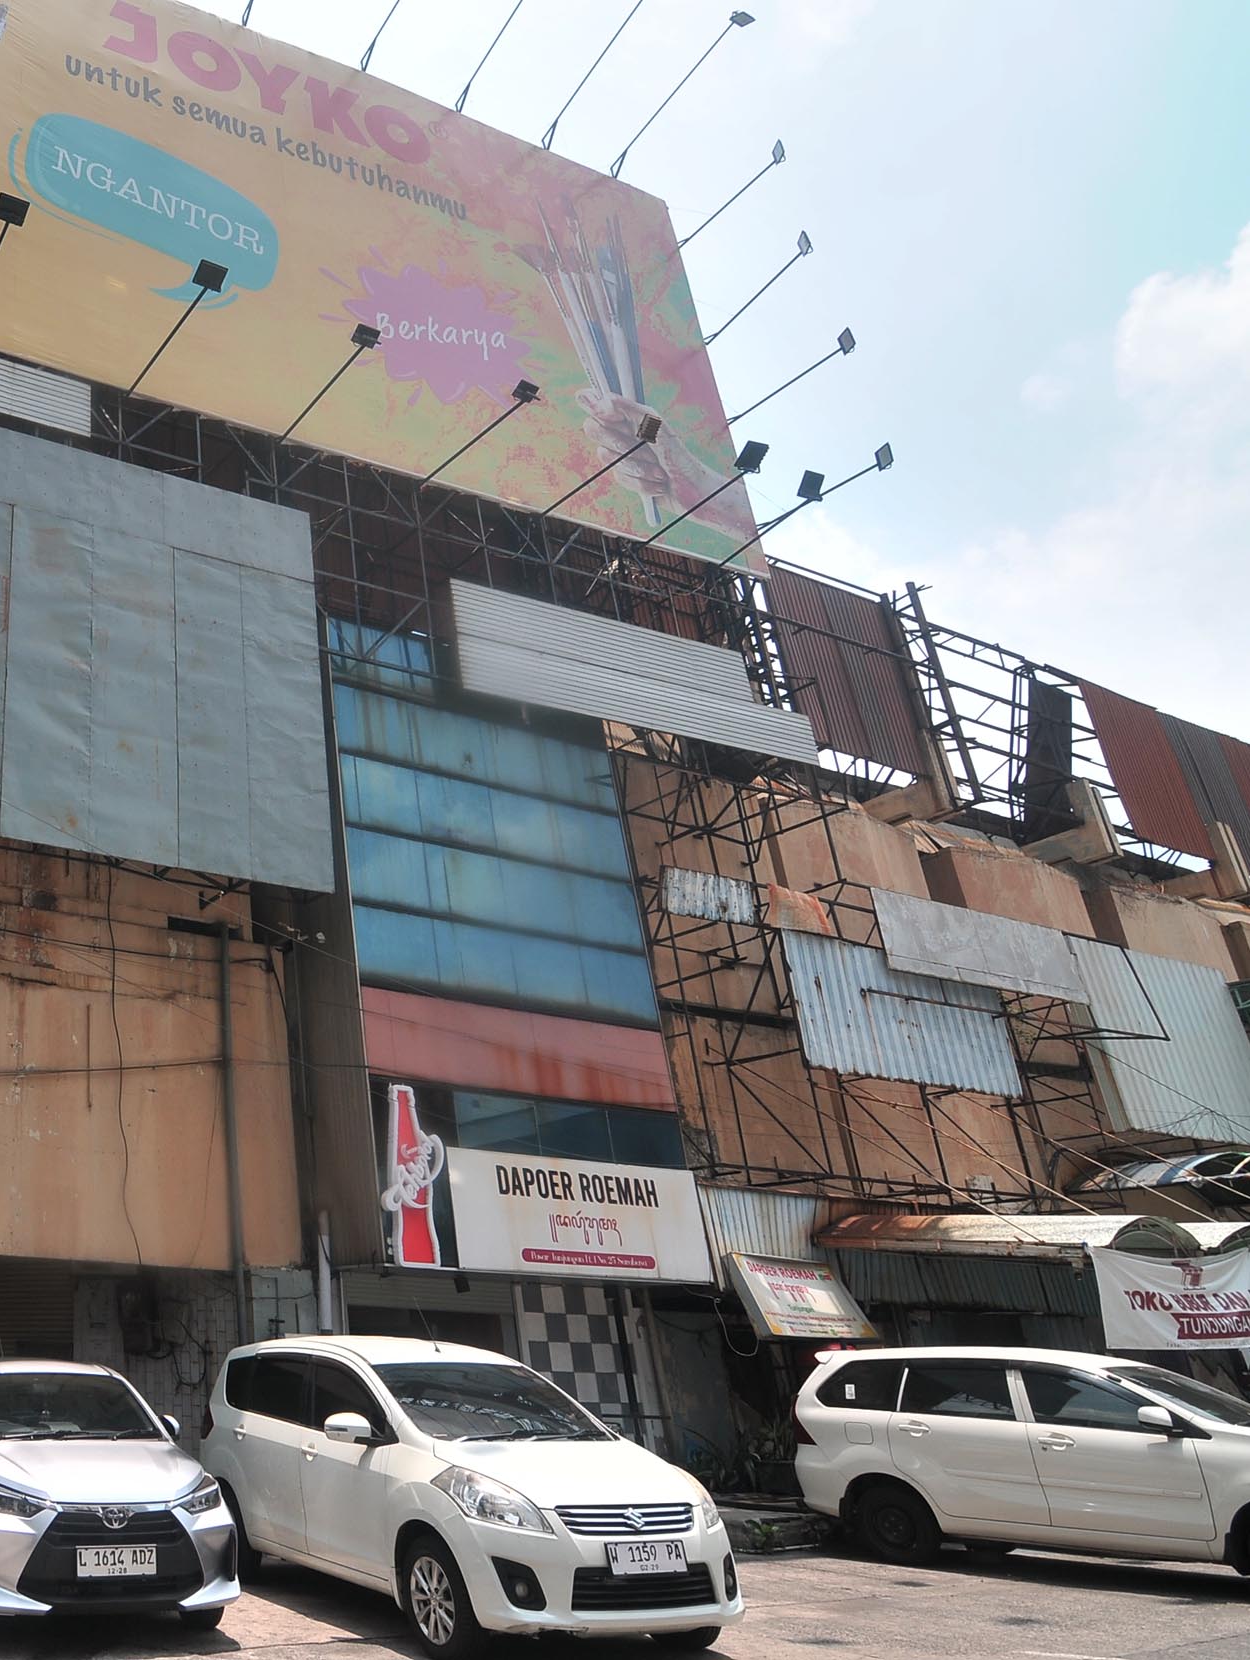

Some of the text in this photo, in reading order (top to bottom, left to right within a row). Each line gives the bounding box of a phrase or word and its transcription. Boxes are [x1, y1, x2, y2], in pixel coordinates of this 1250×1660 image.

[102, 0, 431, 165] JOYKO
[65, 53, 467, 222] untuk semua kebutuhanmu
[51, 144, 265, 257] NGANTOR
[375, 311, 507, 361] Berkarya
[495, 1164, 659, 1208] DAPOER ROEMAH
[778, 1267, 819, 1281] ROEMAH
[78, 1548, 155, 1567] L 1614 ADZ
[609, 1543, 683, 1564] W 1159 PA
